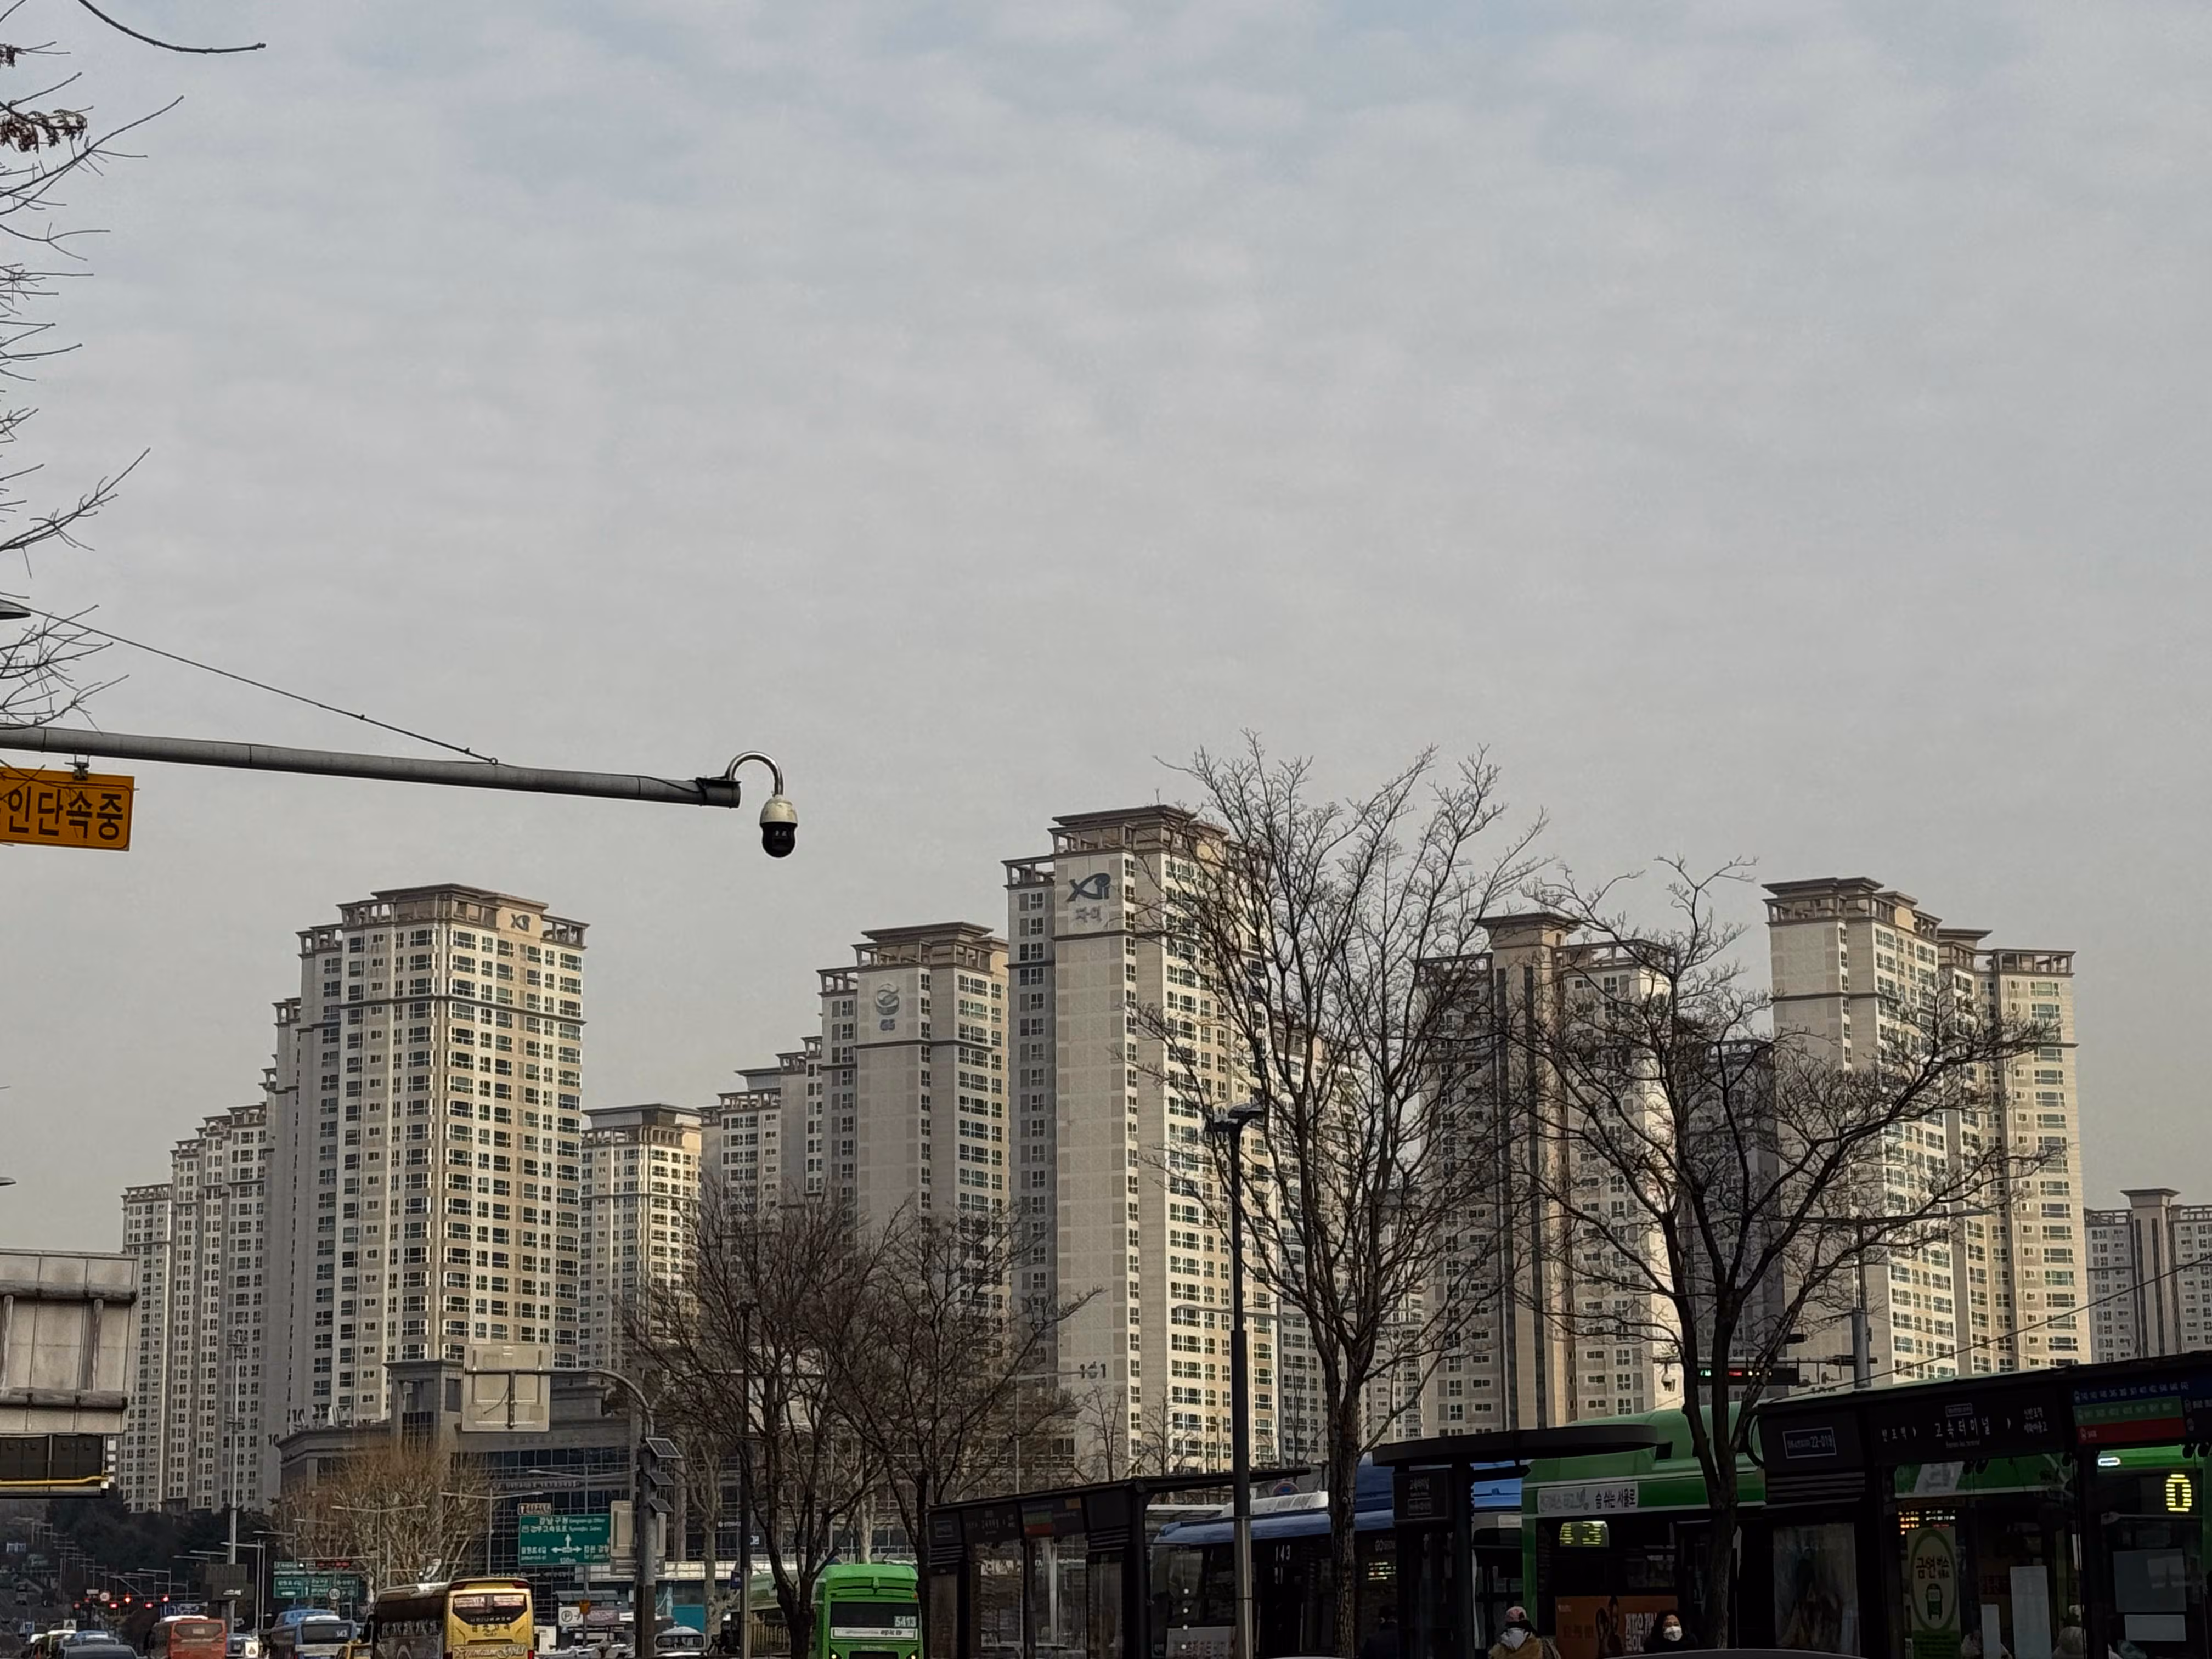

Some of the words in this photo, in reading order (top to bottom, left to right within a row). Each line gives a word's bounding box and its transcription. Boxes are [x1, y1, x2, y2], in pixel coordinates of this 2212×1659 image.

[0, 786, 123, 840] 인단속중
[1079, 1361, 1107, 1379] 11
[1934, 1415, 1991, 1440] 고속터미널
[1916, 1556, 1936, 1579] 금연
[894, 1615, 917, 1628] 5413
